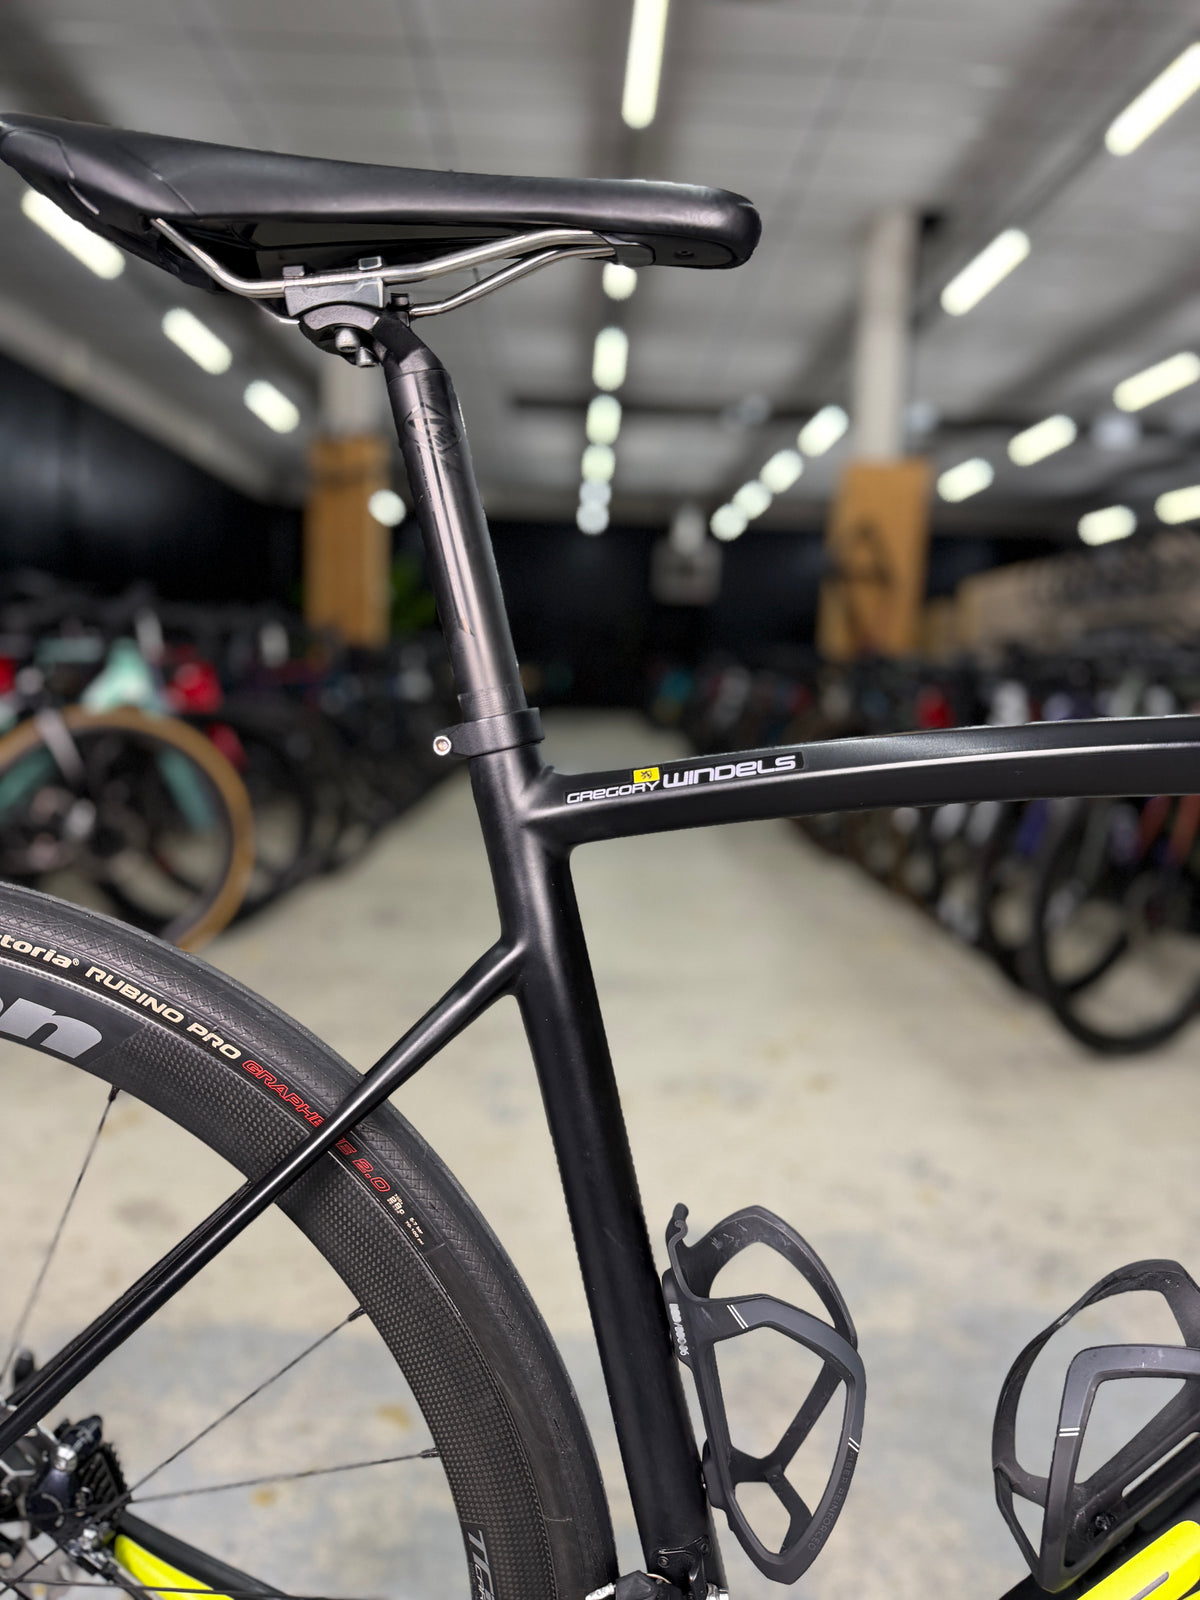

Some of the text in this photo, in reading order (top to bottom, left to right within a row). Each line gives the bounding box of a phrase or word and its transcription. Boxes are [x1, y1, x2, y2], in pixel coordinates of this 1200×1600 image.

[566, 755, 796, 804] GREGORY WINDELS
[0, 997, 103, 1059] n
[84, 965, 185, 1024] RUBINO
[187, 1022, 242, 1060] PRO
[242, 1059, 357, 1156] GRAPHEE
[352, 1158, 391, 1192] 2.0
